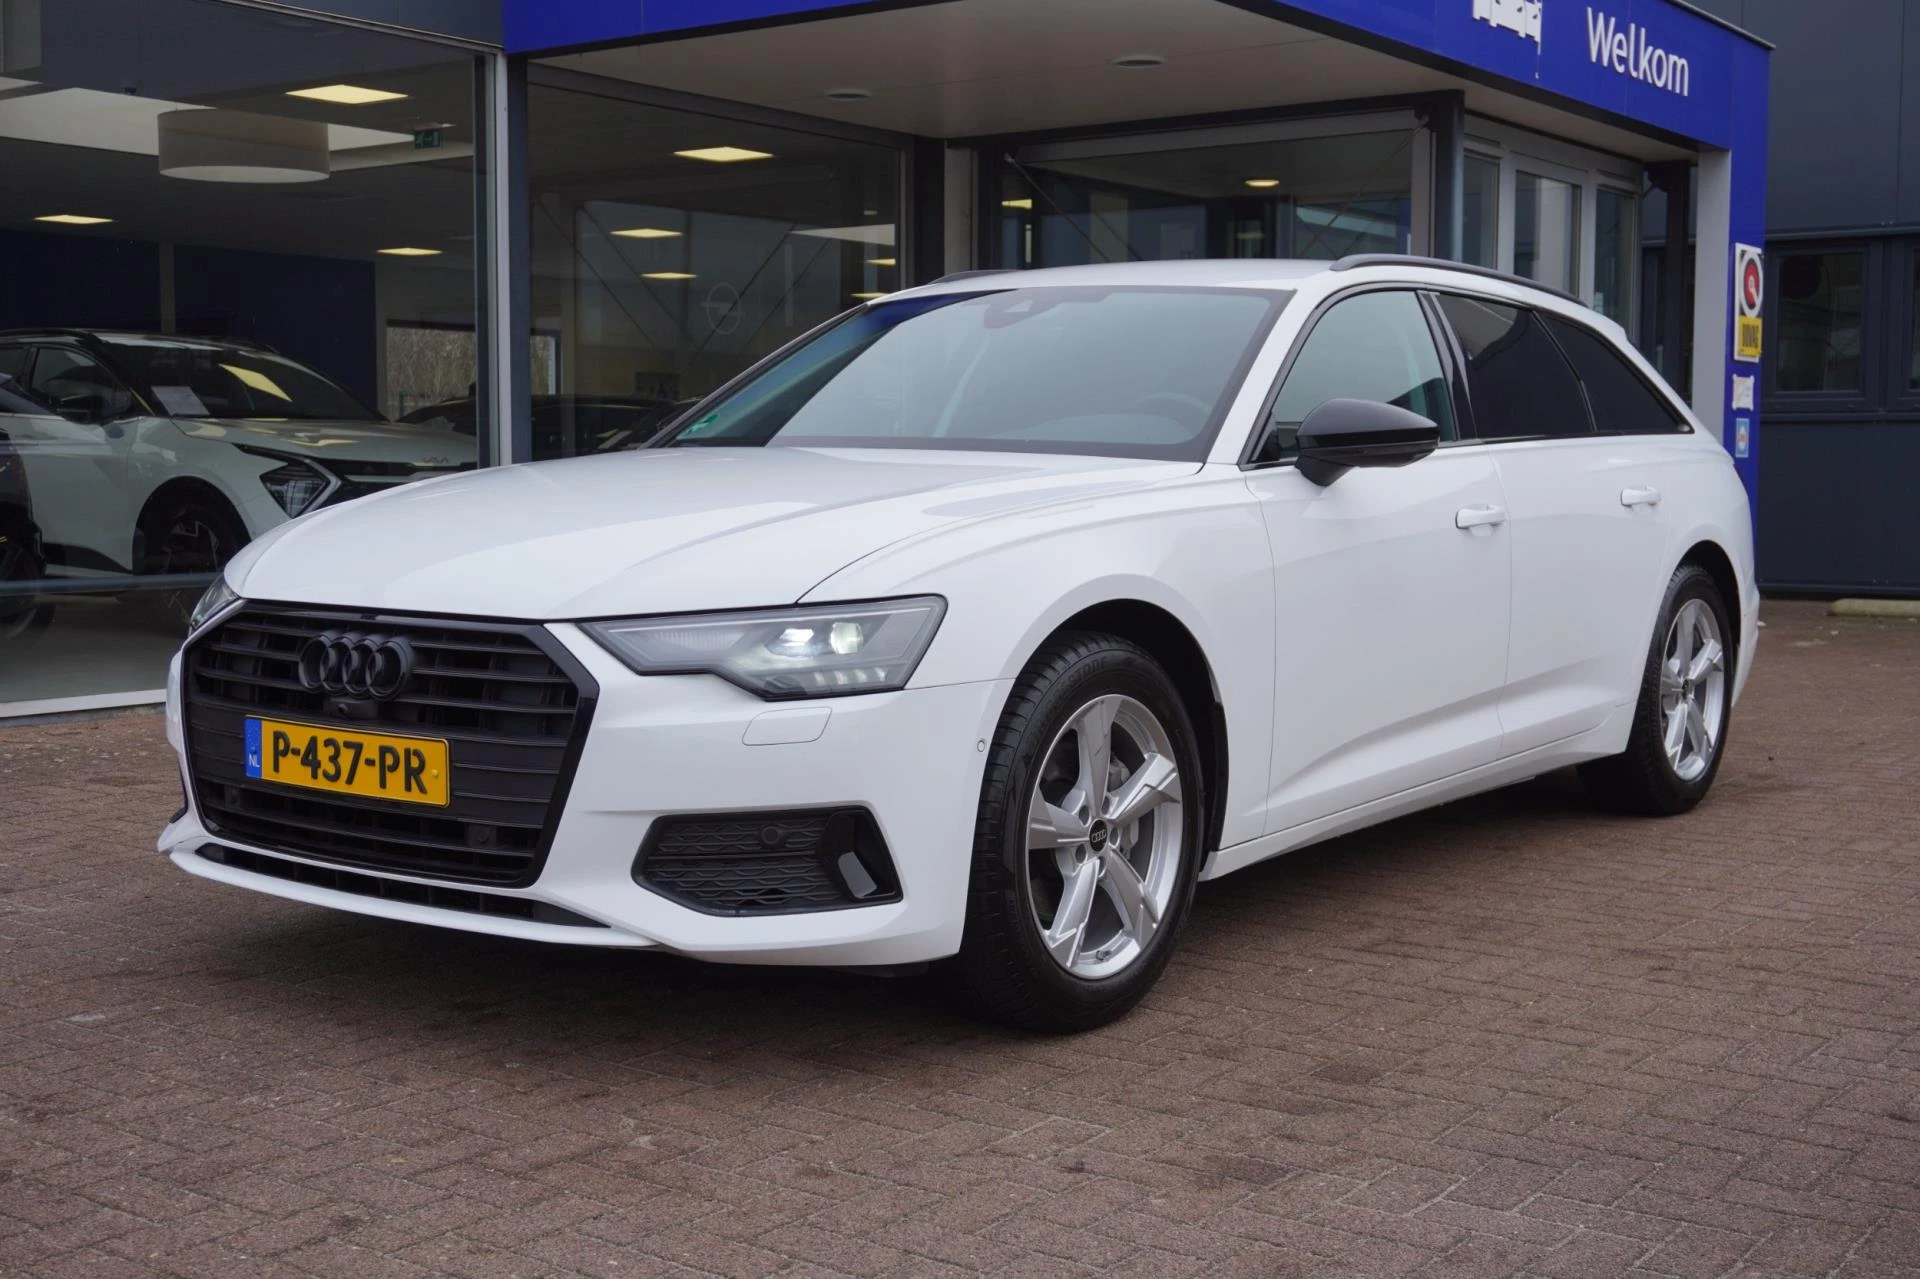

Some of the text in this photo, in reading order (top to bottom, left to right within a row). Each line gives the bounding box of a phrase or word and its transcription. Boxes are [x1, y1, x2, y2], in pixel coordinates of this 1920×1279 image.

[1586, 6, 1689, 96] Welkom
[249, 753, 260, 768] NL
[272, 730, 428, 795] P-437-PR
